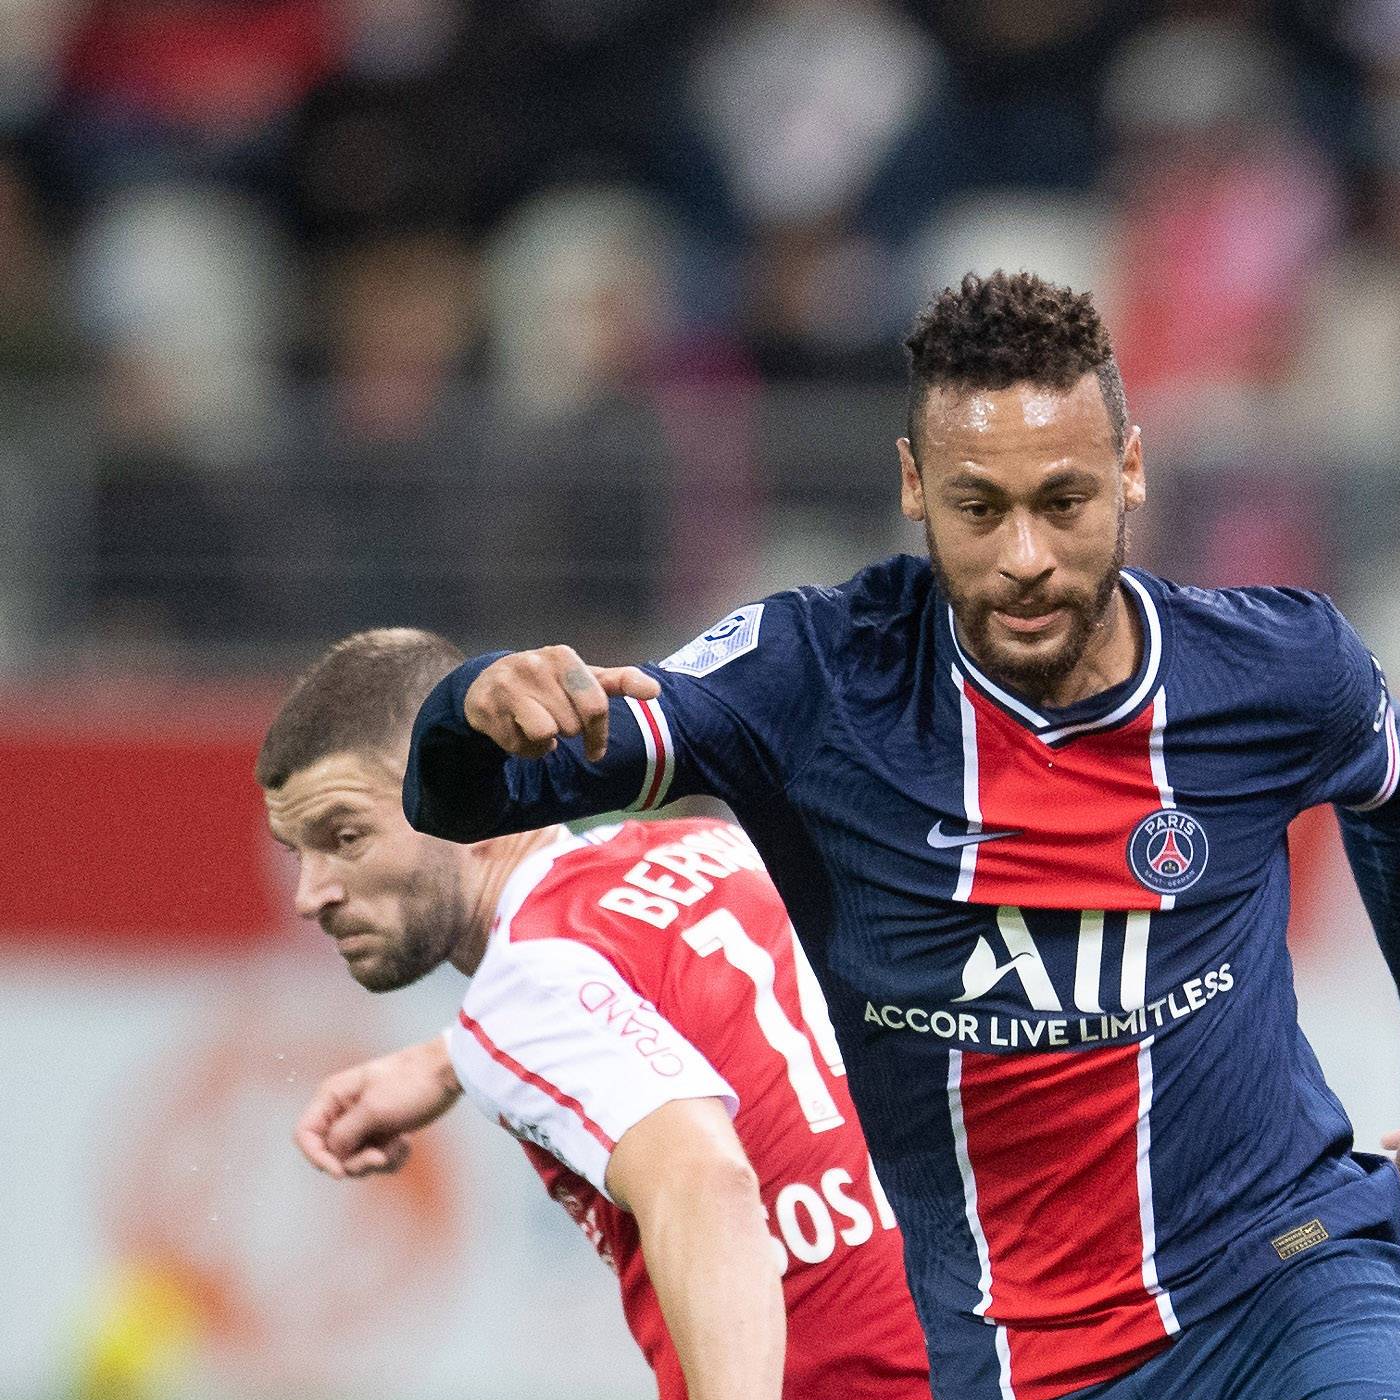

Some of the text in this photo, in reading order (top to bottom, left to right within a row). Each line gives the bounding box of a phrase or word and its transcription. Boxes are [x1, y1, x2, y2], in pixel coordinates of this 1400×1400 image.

[1145, 815, 1196, 836] PARIS
[864, 963, 1234, 1047] ACCOR LIVE LIMITLESS
